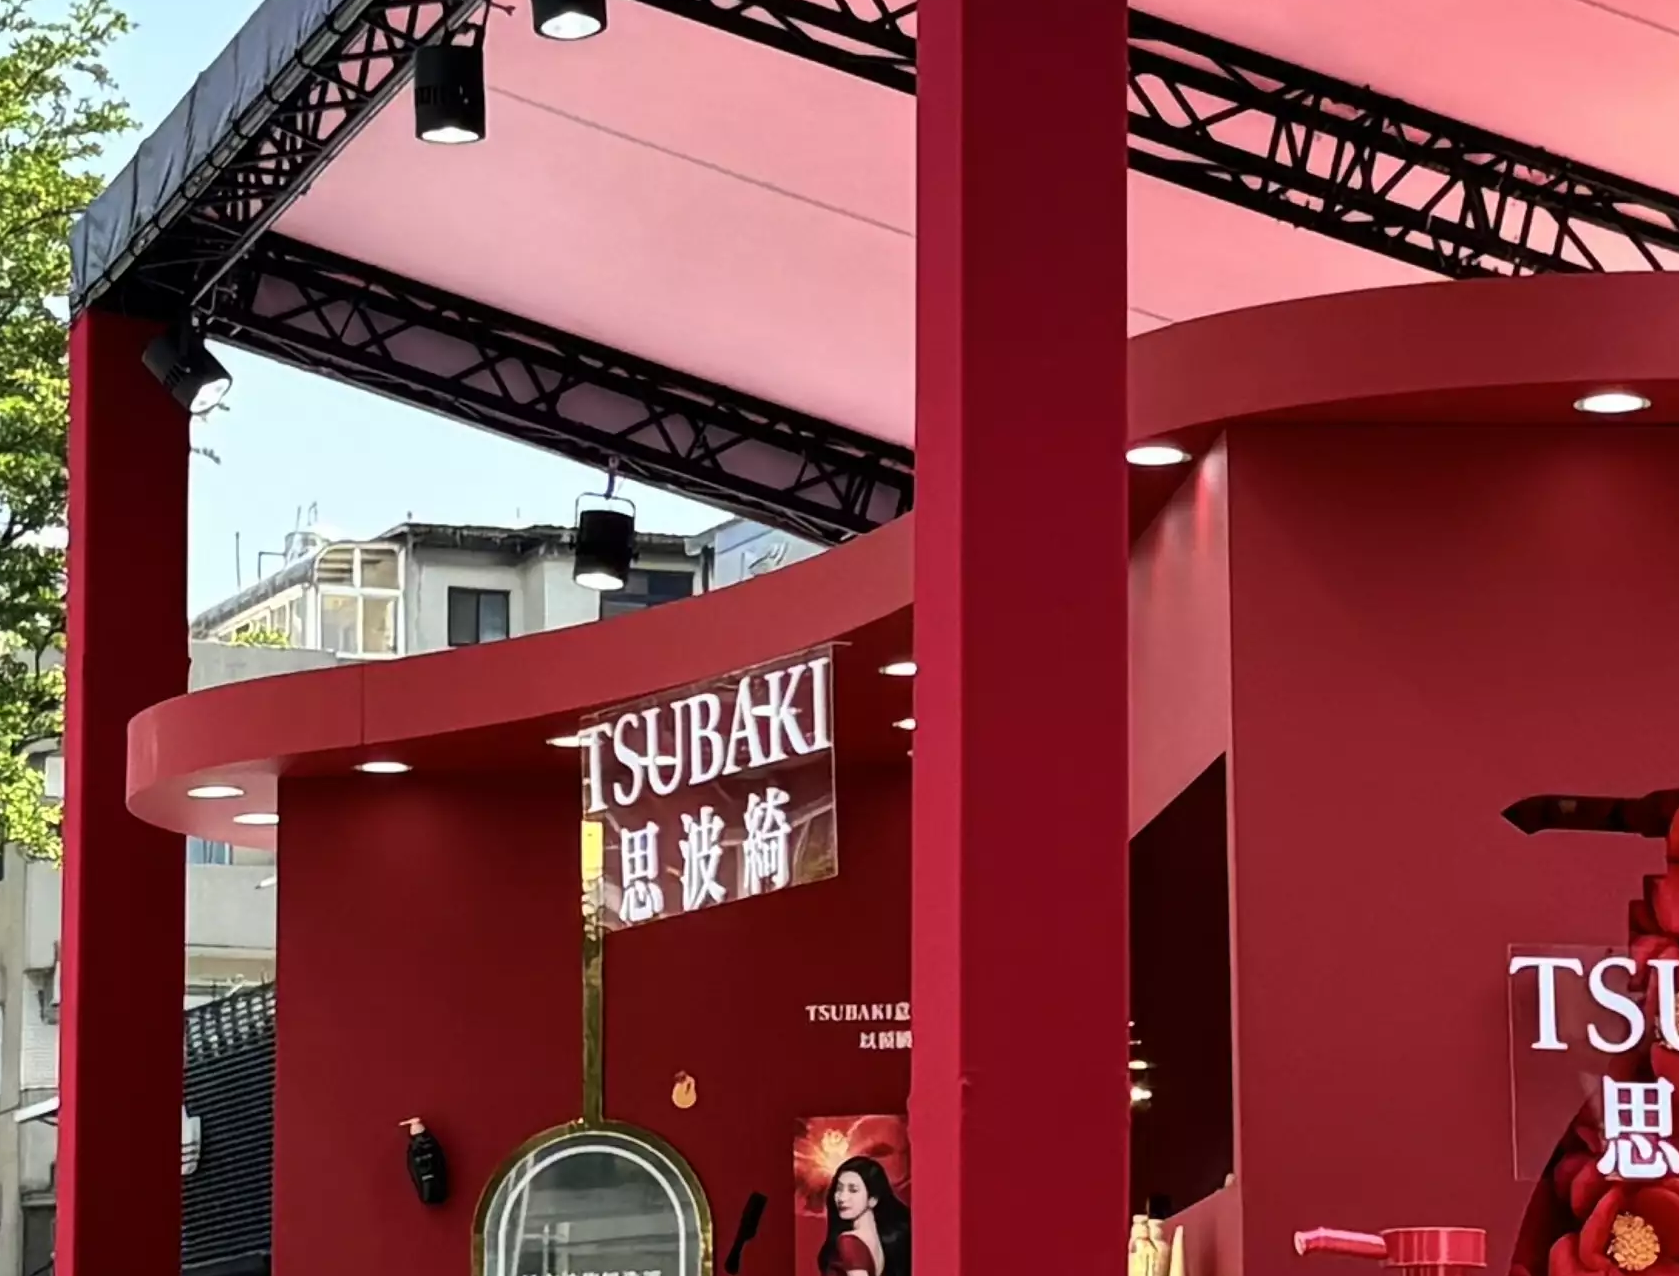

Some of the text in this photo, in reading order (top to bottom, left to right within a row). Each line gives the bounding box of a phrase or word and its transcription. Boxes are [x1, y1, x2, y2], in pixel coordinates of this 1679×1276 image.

[578, 657, 832, 814] TSUBAKI
[618, 785, 793, 924] 思波綺
